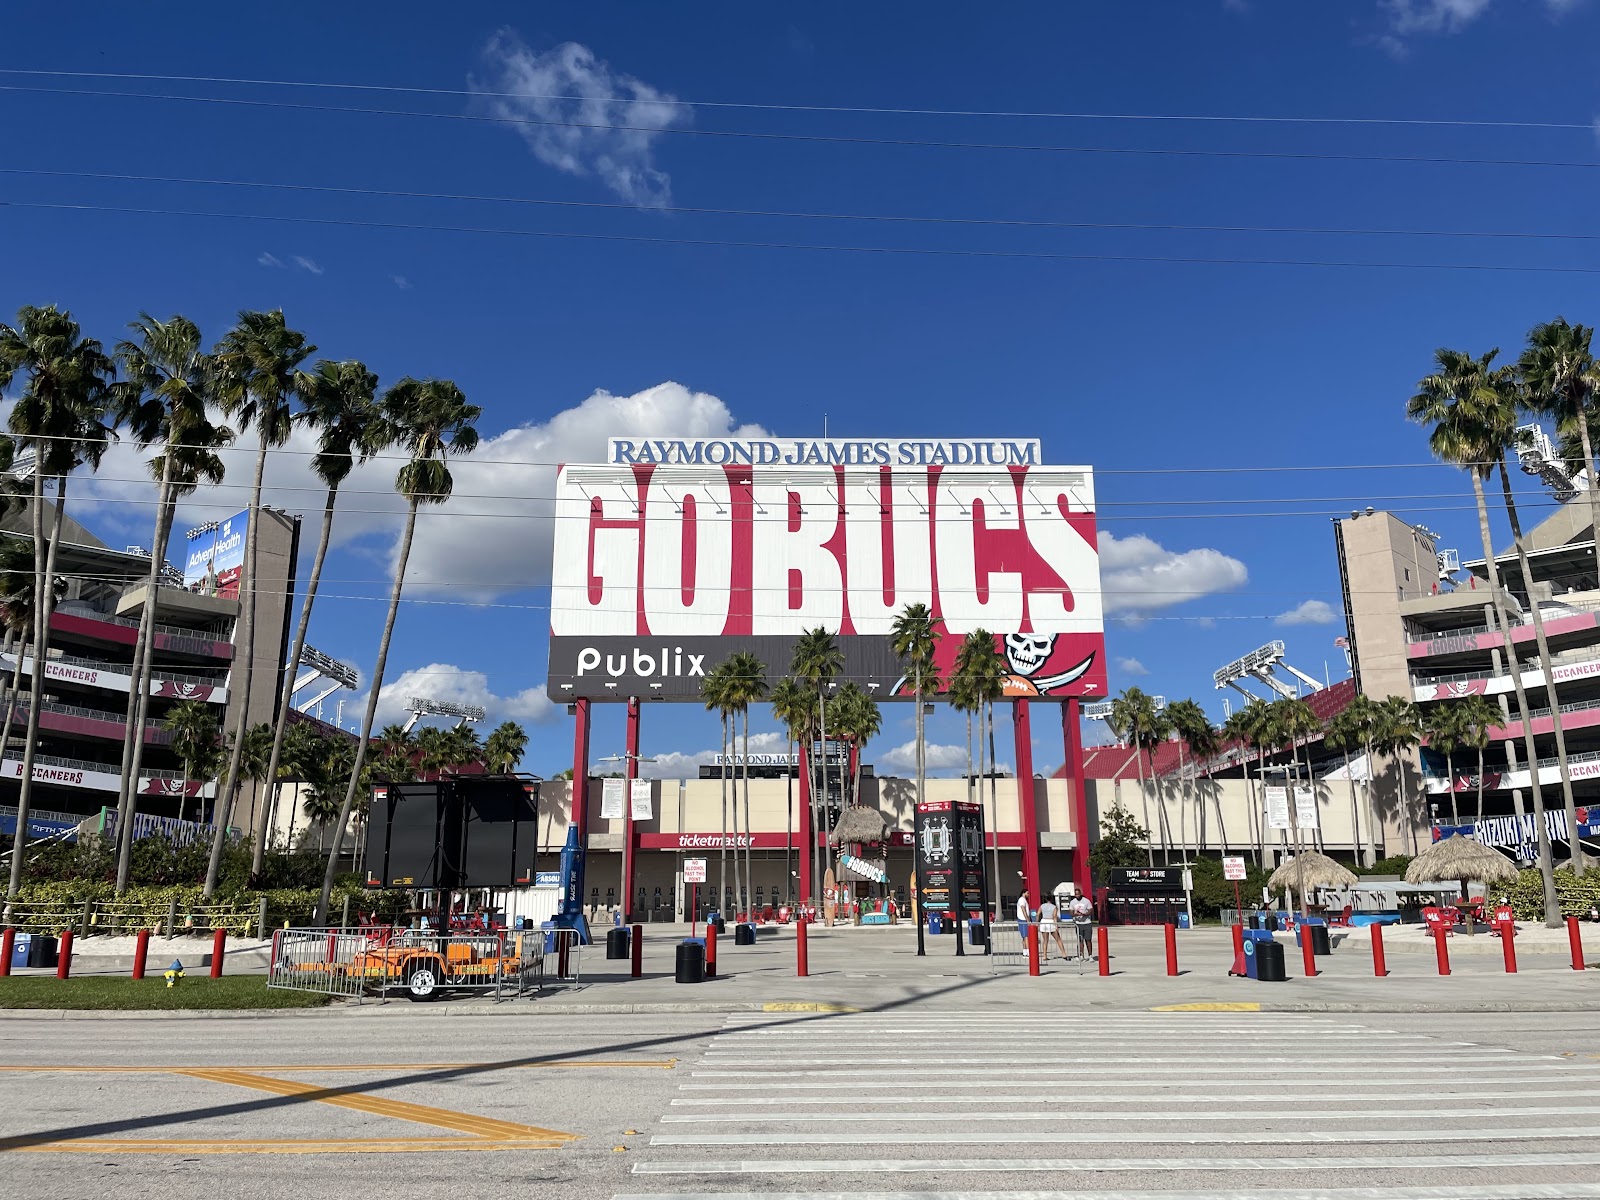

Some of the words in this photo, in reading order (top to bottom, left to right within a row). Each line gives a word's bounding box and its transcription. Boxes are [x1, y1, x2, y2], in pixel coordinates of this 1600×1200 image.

[613, 440, 779, 465] RAYMOND
[785, 440, 892, 465] JAMES
[897, 440, 1038, 465] STADIUM
[550, 464, 733, 636] GO
[753, 464, 1104, 635] BUCS
[163, 635, 215, 657] #GOBUCS
[1427, 635, 1478, 655] #GOBUCS
[577, 646, 706, 677] Publix
[46, 664, 98, 683] CCANEERS
[16, 764, 83, 784] BCCANEERS
[33, 825, 56, 834] FIFTH
[1475, 816, 1520, 847] SUZUKI
[679, 834, 755, 847] ticketmaster
[1515, 844, 1534, 860] GATE
[846, 855, 884, 883] #GOBUCS
